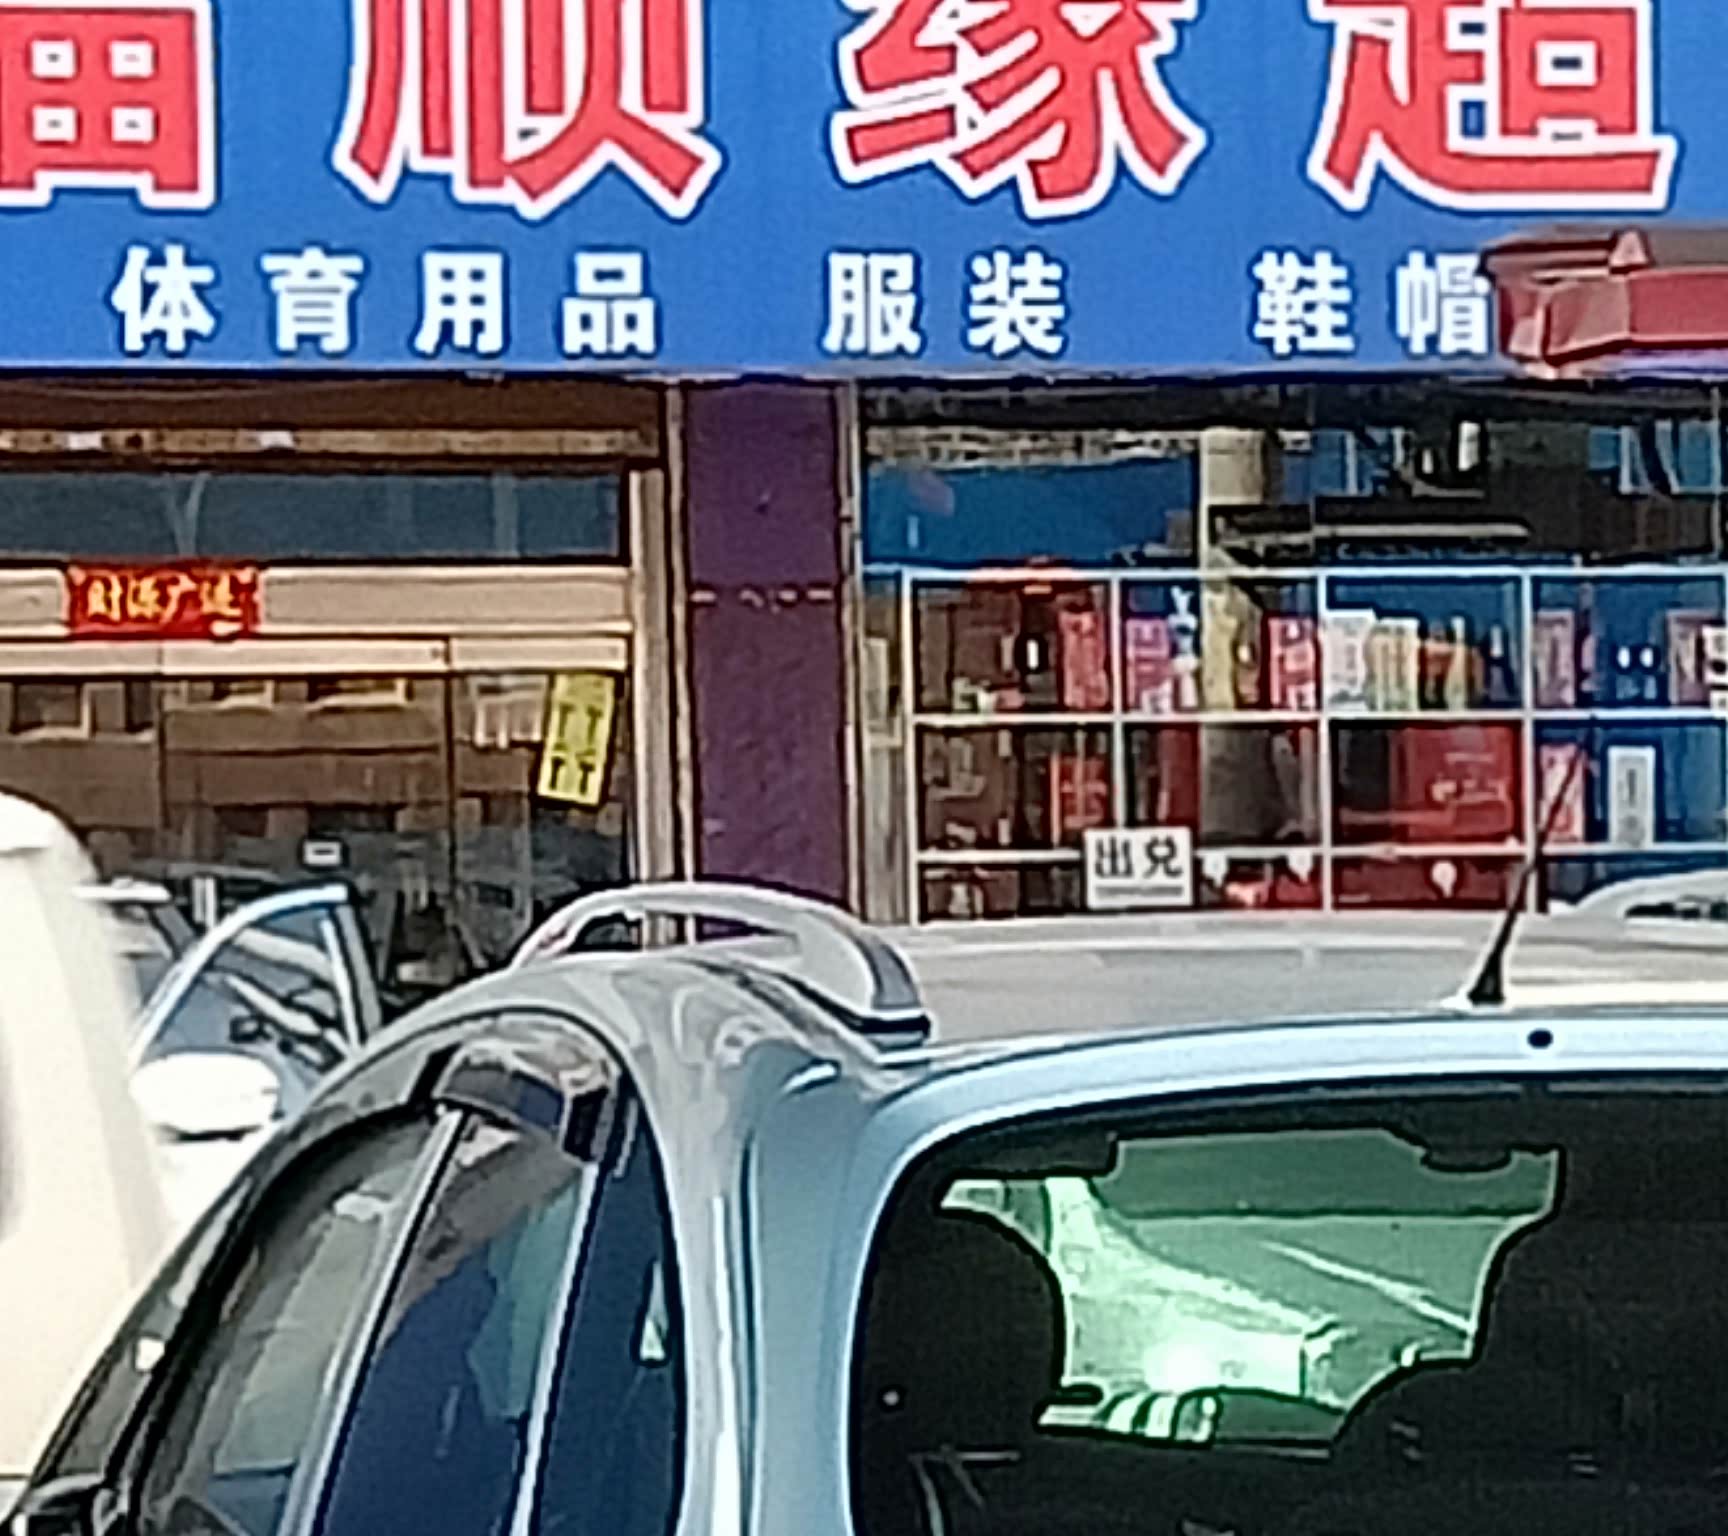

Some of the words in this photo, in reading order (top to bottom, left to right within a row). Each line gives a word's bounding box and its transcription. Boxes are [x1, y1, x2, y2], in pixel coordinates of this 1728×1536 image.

[110, 244, 661, 356] 体育用品
[820, 251, 1066, 357] 服装
[1252, 250, 1493, 356] 鞋帽
[1094, 834, 1184, 880] 出兑
